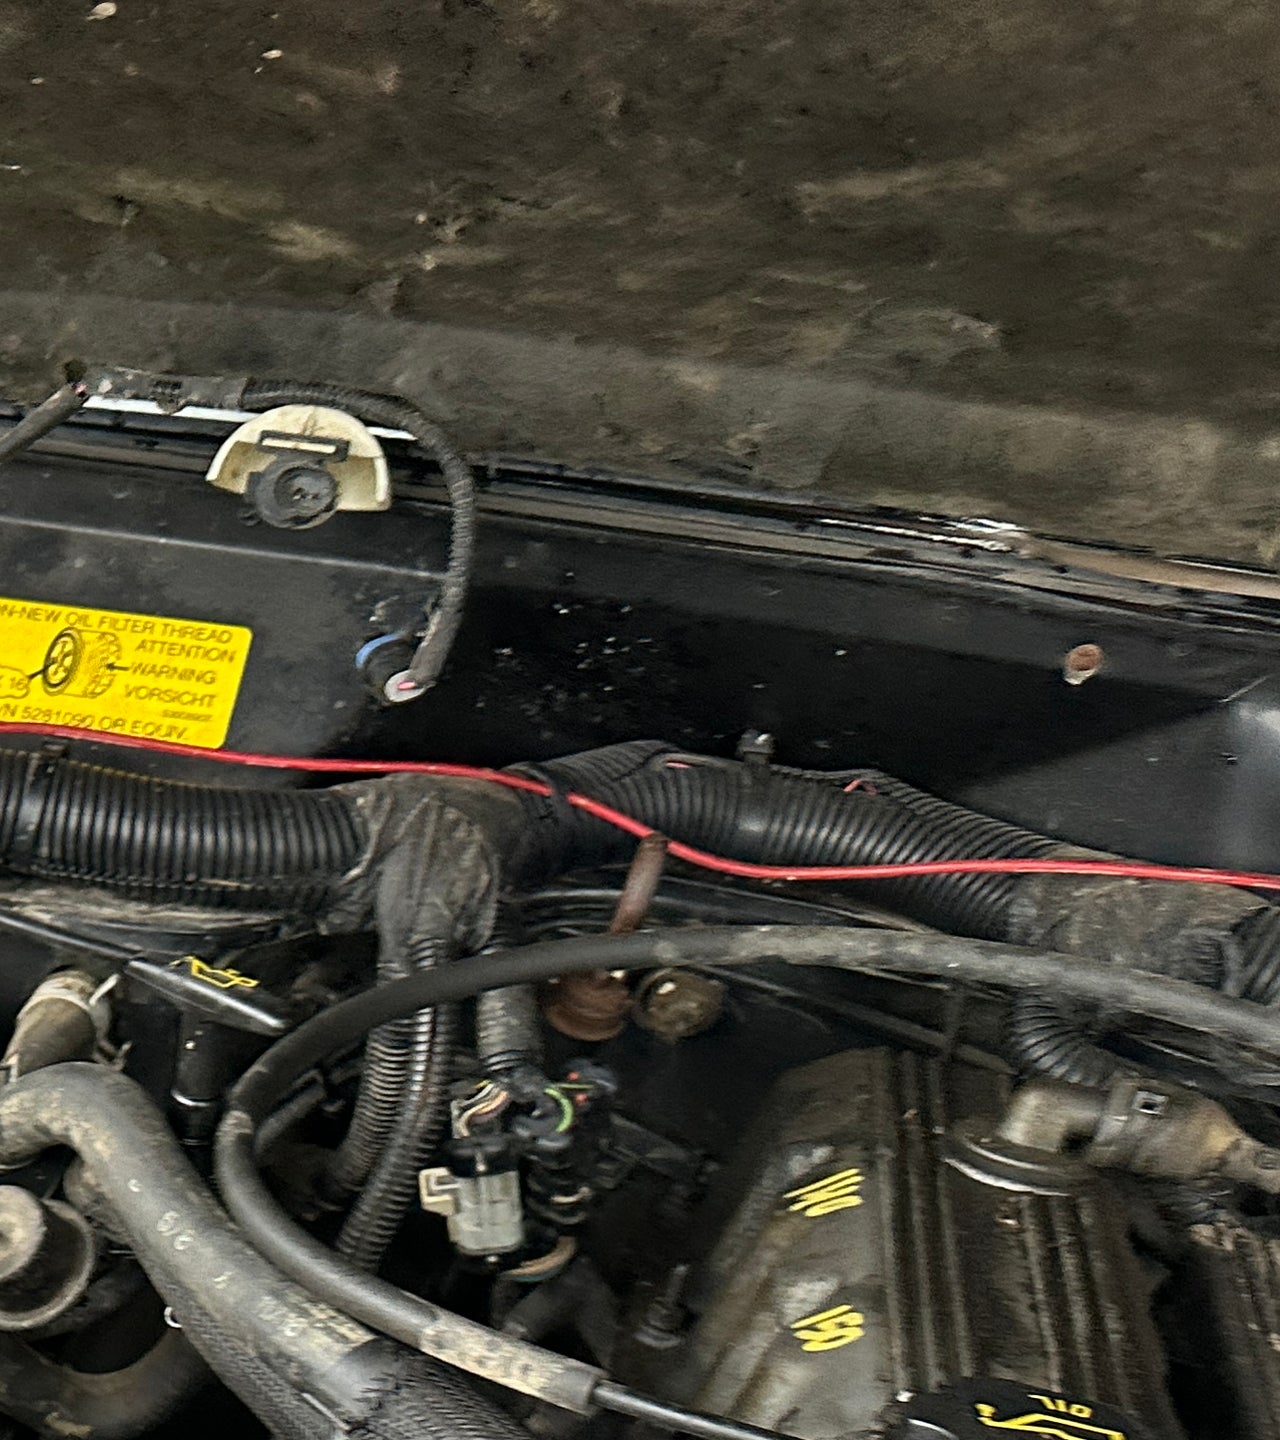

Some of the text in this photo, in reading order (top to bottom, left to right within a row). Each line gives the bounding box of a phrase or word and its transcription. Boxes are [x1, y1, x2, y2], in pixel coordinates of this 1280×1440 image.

[65, 611, 94, 628] OIL
[97, 614, 155, 636] FILTER
[160, 622, 233, 644] THREAD
[135, 639, 237, 664] ATTENTION
[130, 661, 217, 685] WARNING
[124, 685, 217, 708] VORSICHT
[98, 714, 127, 732] OR
[1028, 1394, 1093, 1420] OIL
